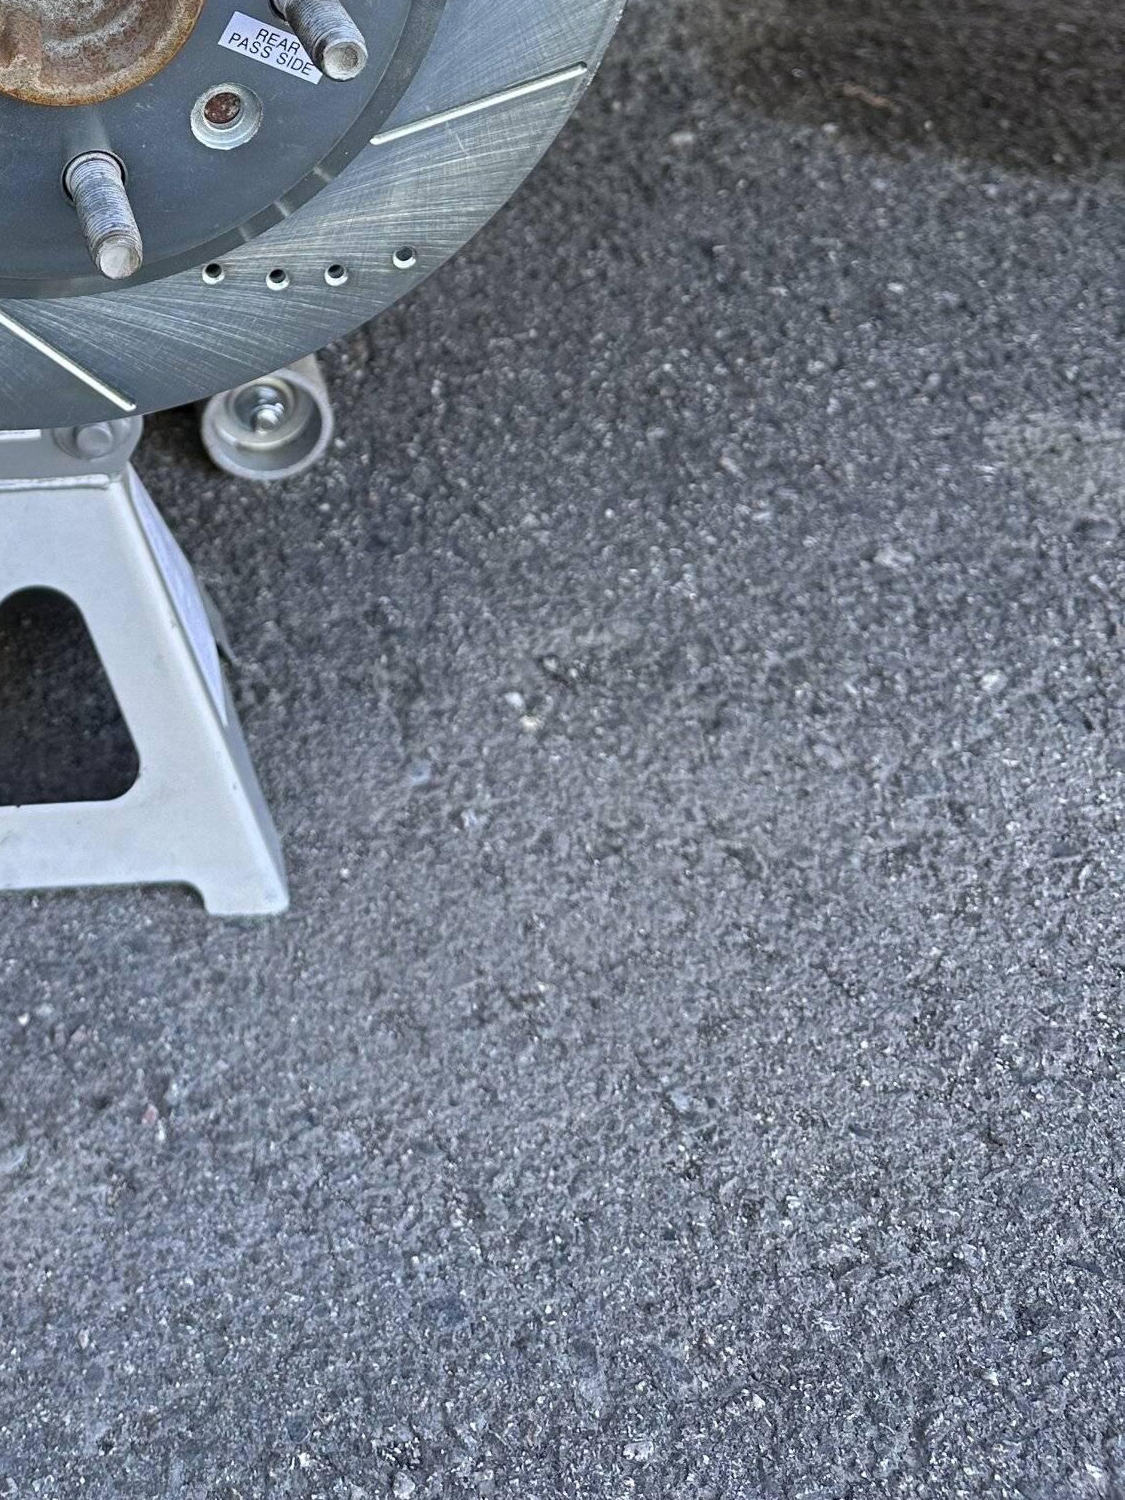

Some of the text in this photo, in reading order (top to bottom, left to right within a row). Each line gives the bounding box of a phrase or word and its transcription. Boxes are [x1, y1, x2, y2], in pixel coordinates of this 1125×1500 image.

[228, 32, 316, 76] PASS SIDE
[255, 28, 301, 56] REAR
